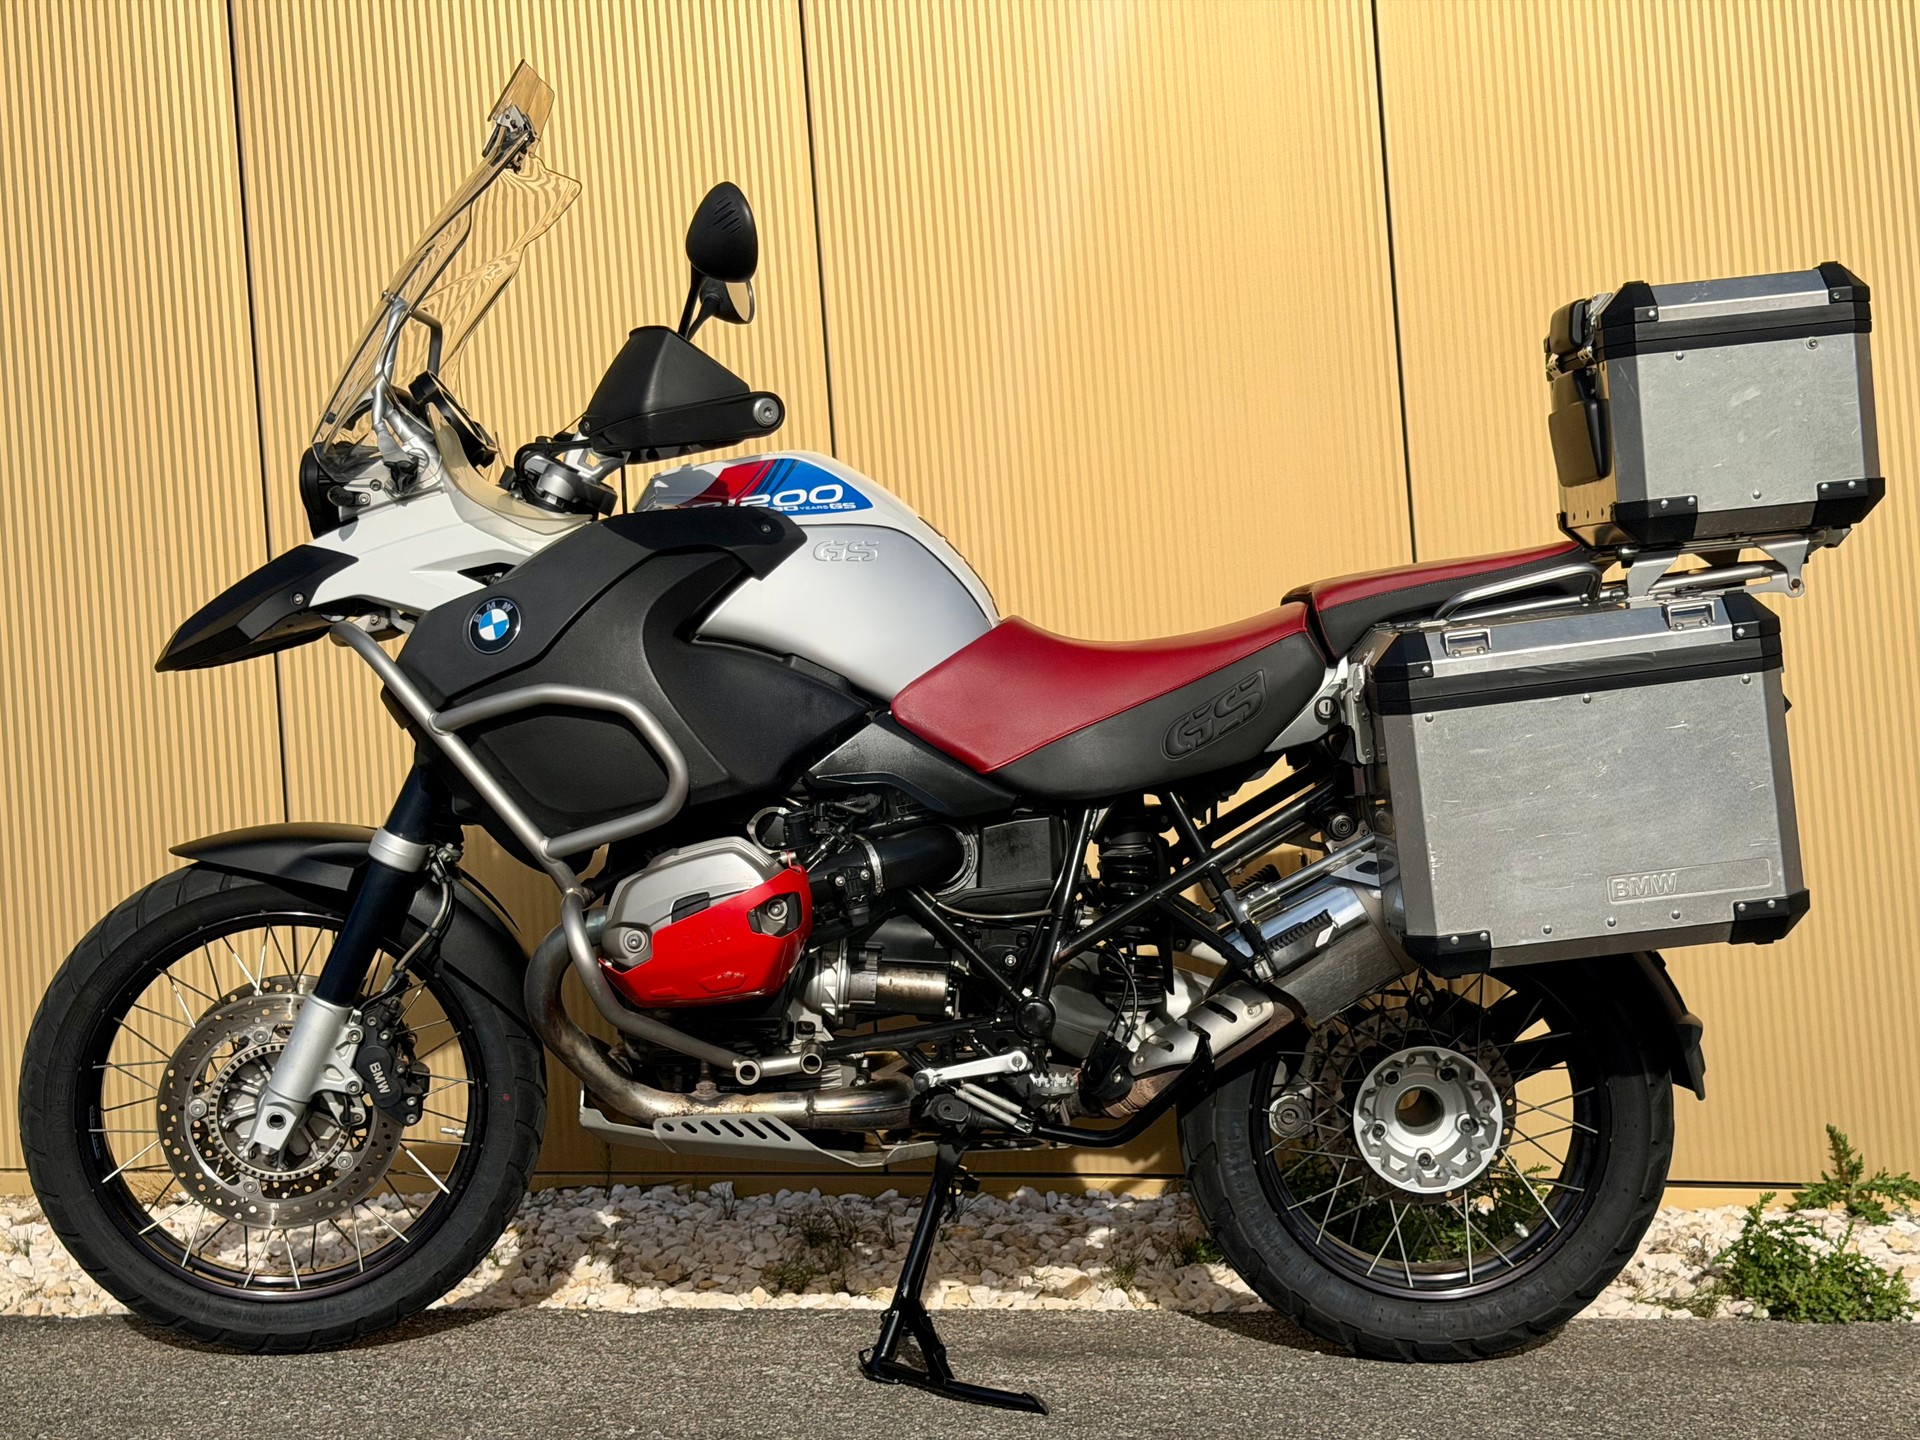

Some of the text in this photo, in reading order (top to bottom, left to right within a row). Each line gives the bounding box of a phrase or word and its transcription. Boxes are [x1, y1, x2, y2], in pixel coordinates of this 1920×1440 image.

[829, 502, 857, 511] GS
[812, 539, 880, 563] GS
[473, 601, 514, 623] BMW
[1164, 674, 1264, 757] GS
[1612, 872, 1678, 899] BMW
[369, 1061, 391, 1094] BMW
